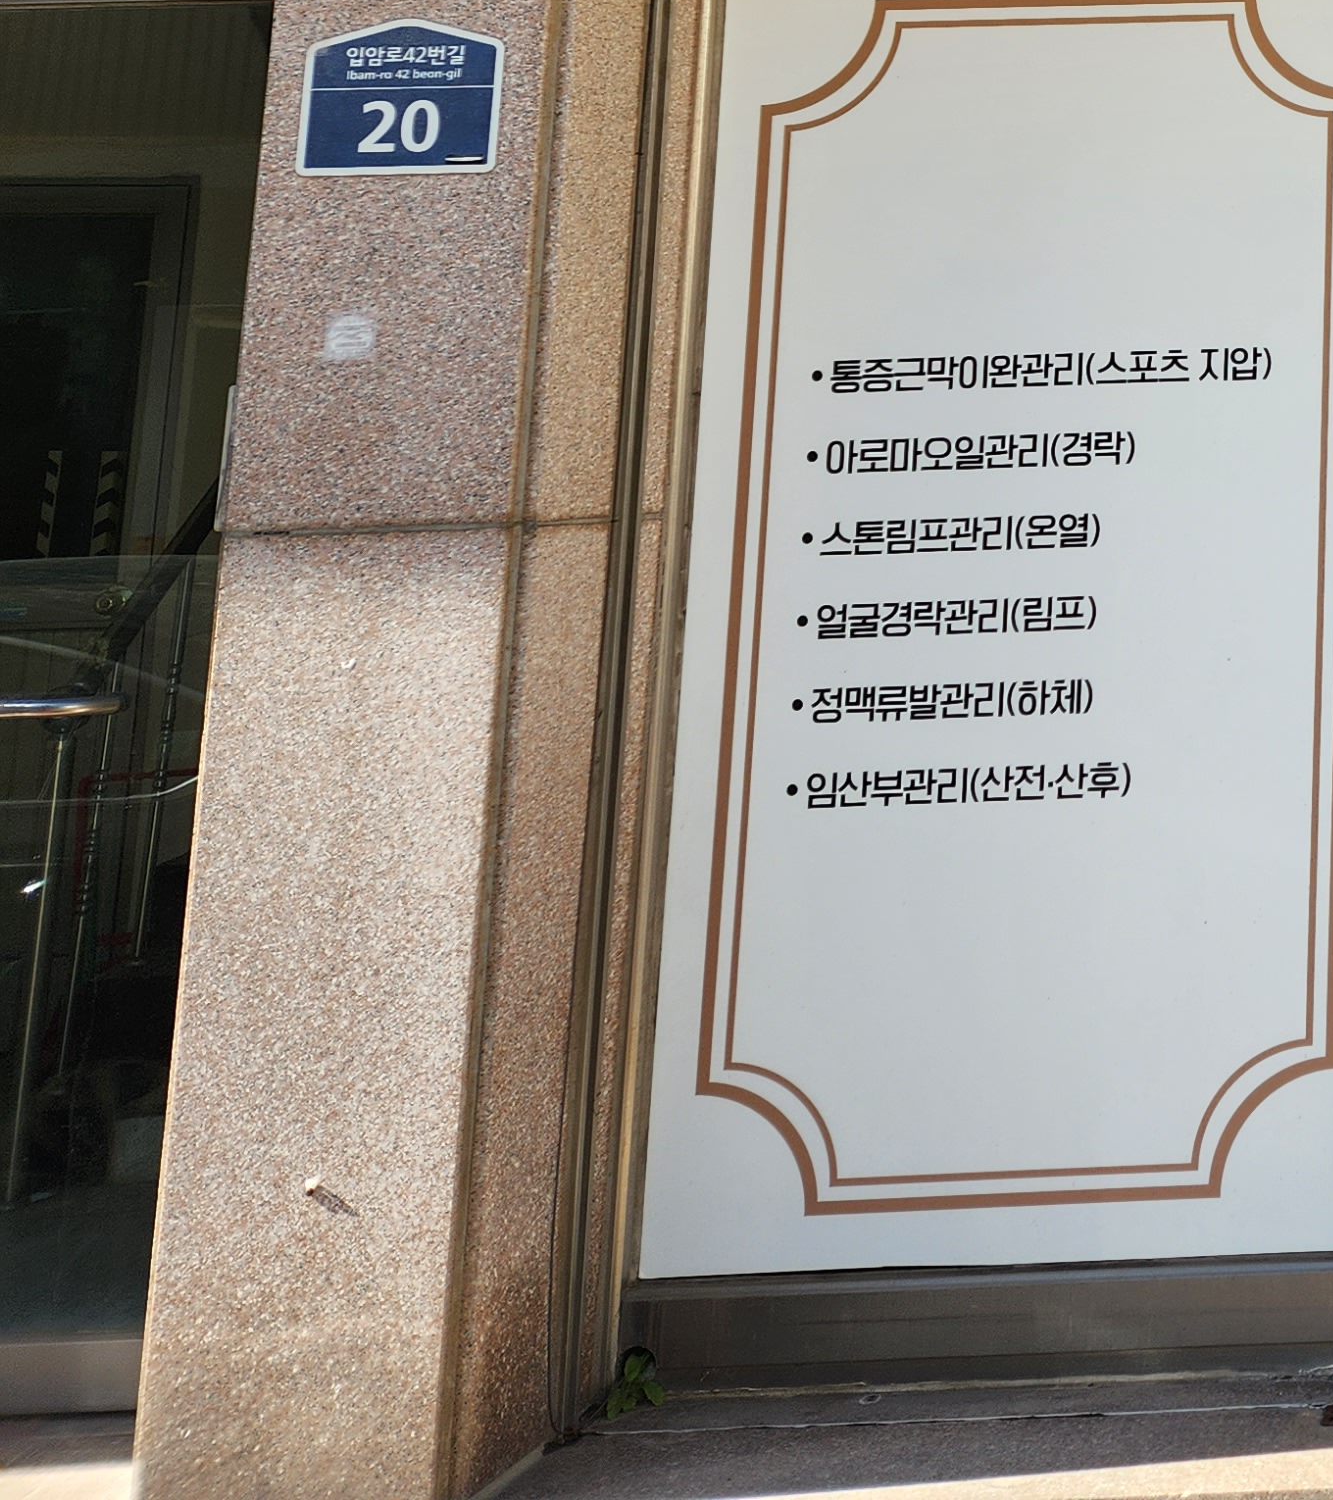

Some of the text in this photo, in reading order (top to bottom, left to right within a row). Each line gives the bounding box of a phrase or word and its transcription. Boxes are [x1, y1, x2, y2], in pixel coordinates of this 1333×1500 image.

[345, 44, 467, 68] 입암로42번길
[394, 69, 411, 80] 42
[412, 68, 463, 81] beon-gil
[357, 99, 441, 153] 20
[829, 346, 1273, 395] 통증근막이완관리(스포츠 지압)
[825, 430, 1136, 476] 아로마오일관리(경락)
[818, 513, 1102, 558] 스톤림프관리(온열)
[815, 595, 1098, 641] 얼굴경락관리(림프)
[810, 678, 1094, 725] 정맥류발관리(하체)
